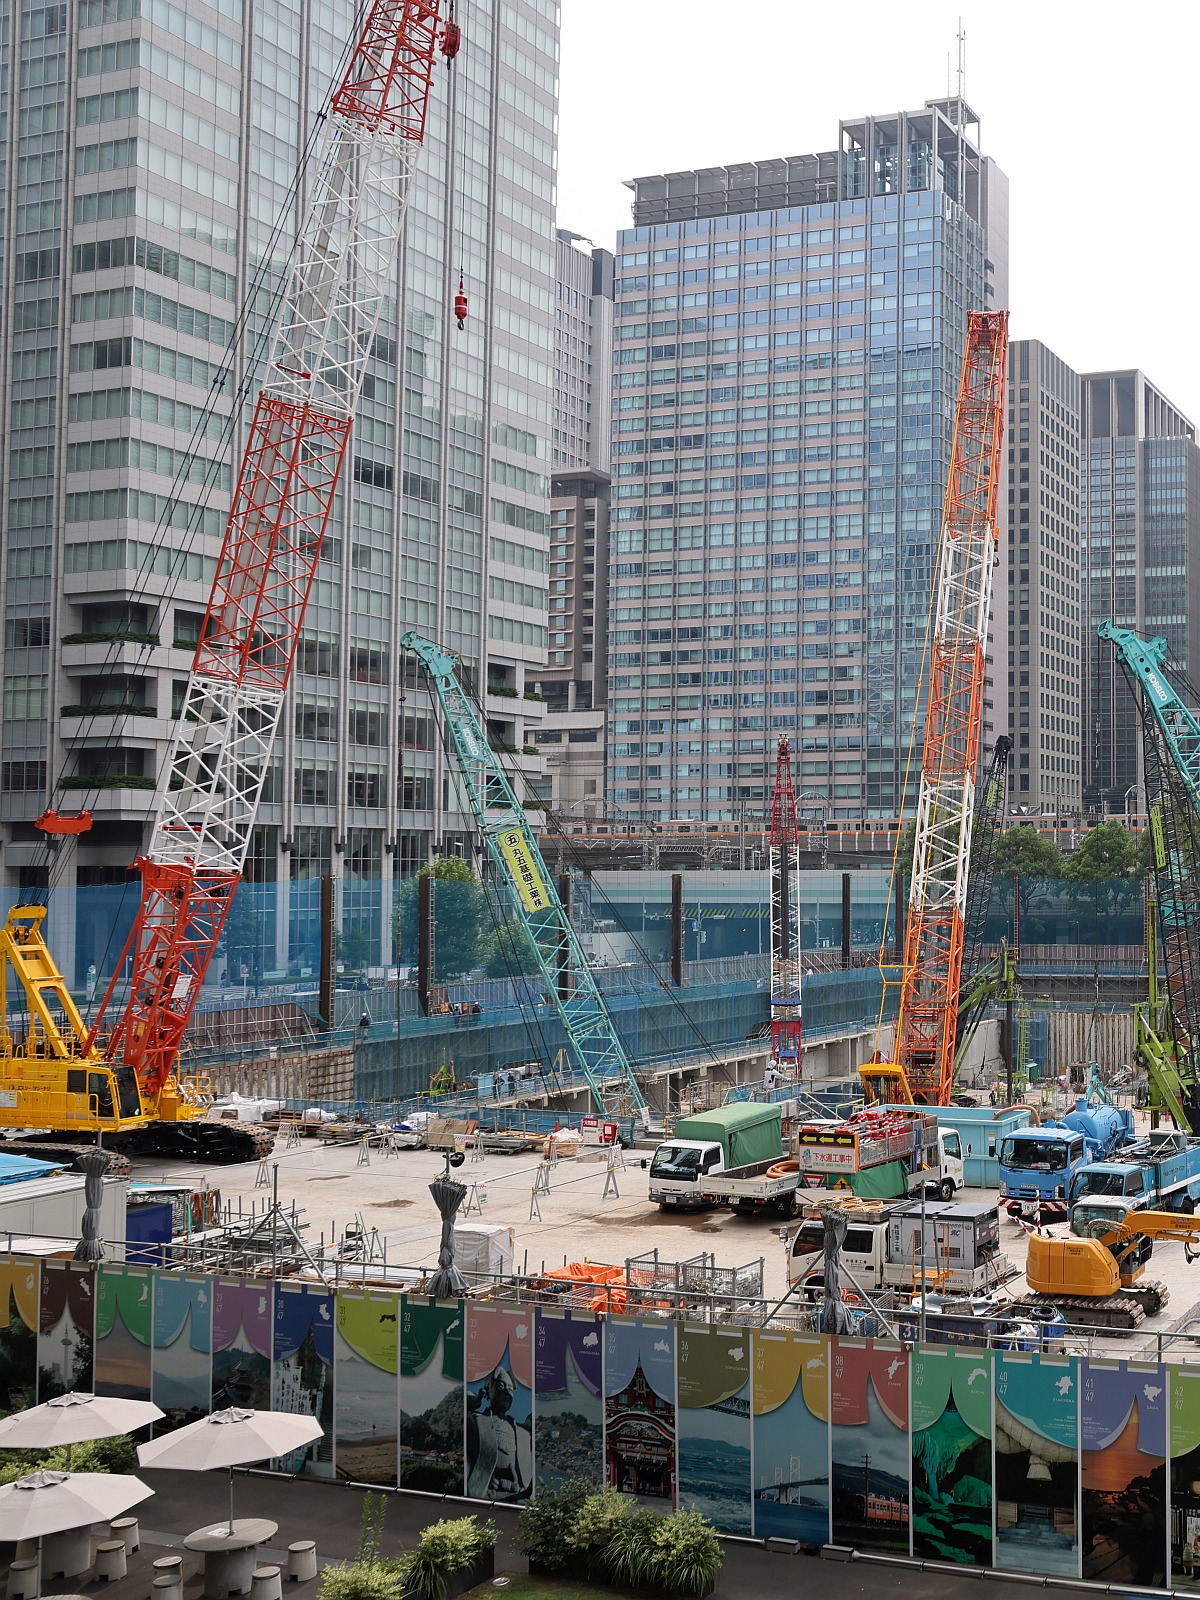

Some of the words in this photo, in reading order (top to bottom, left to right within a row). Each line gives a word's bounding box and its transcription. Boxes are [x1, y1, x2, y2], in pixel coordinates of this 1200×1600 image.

[1147, 672, 1168, 701] KOBELCO
[462, 728, 478, 756] KOBELCO
[813, 1152, 852, 1163] 下水道工事中
[277, 1312, 283, 1320] 47
[340, 1317, 346, 1326] 47
[404, 1324, 410, 1333] 47
[470, 1331, 477, 1340] 47
[538, 1338, 546, 1348] 47
[681, 1341, 689, 1350] 36
[608, 1346, 615, 1355] 47
[757, 1348, 764, 1357] 37
[681, 1353, 689, 1362] 47
[835, 1356, 844, 1365] 38
[757, 1361, 764, 1370] 47
[916, 1364, 924, 1373] 39
[835, 1369, 844, 1378] 47
[999, 1372, 1008, 1381] 40
[916, 1377, 924, 1386] 47
[1086, 1379, 1094, 1388] 41
[999, 1385, 1008, 1395] 47
[1174, 1387, 1183, 1396] 42
[1086, 1392, 1094, 1402] 47
[1174, 1400, 1183, 1410] 47
